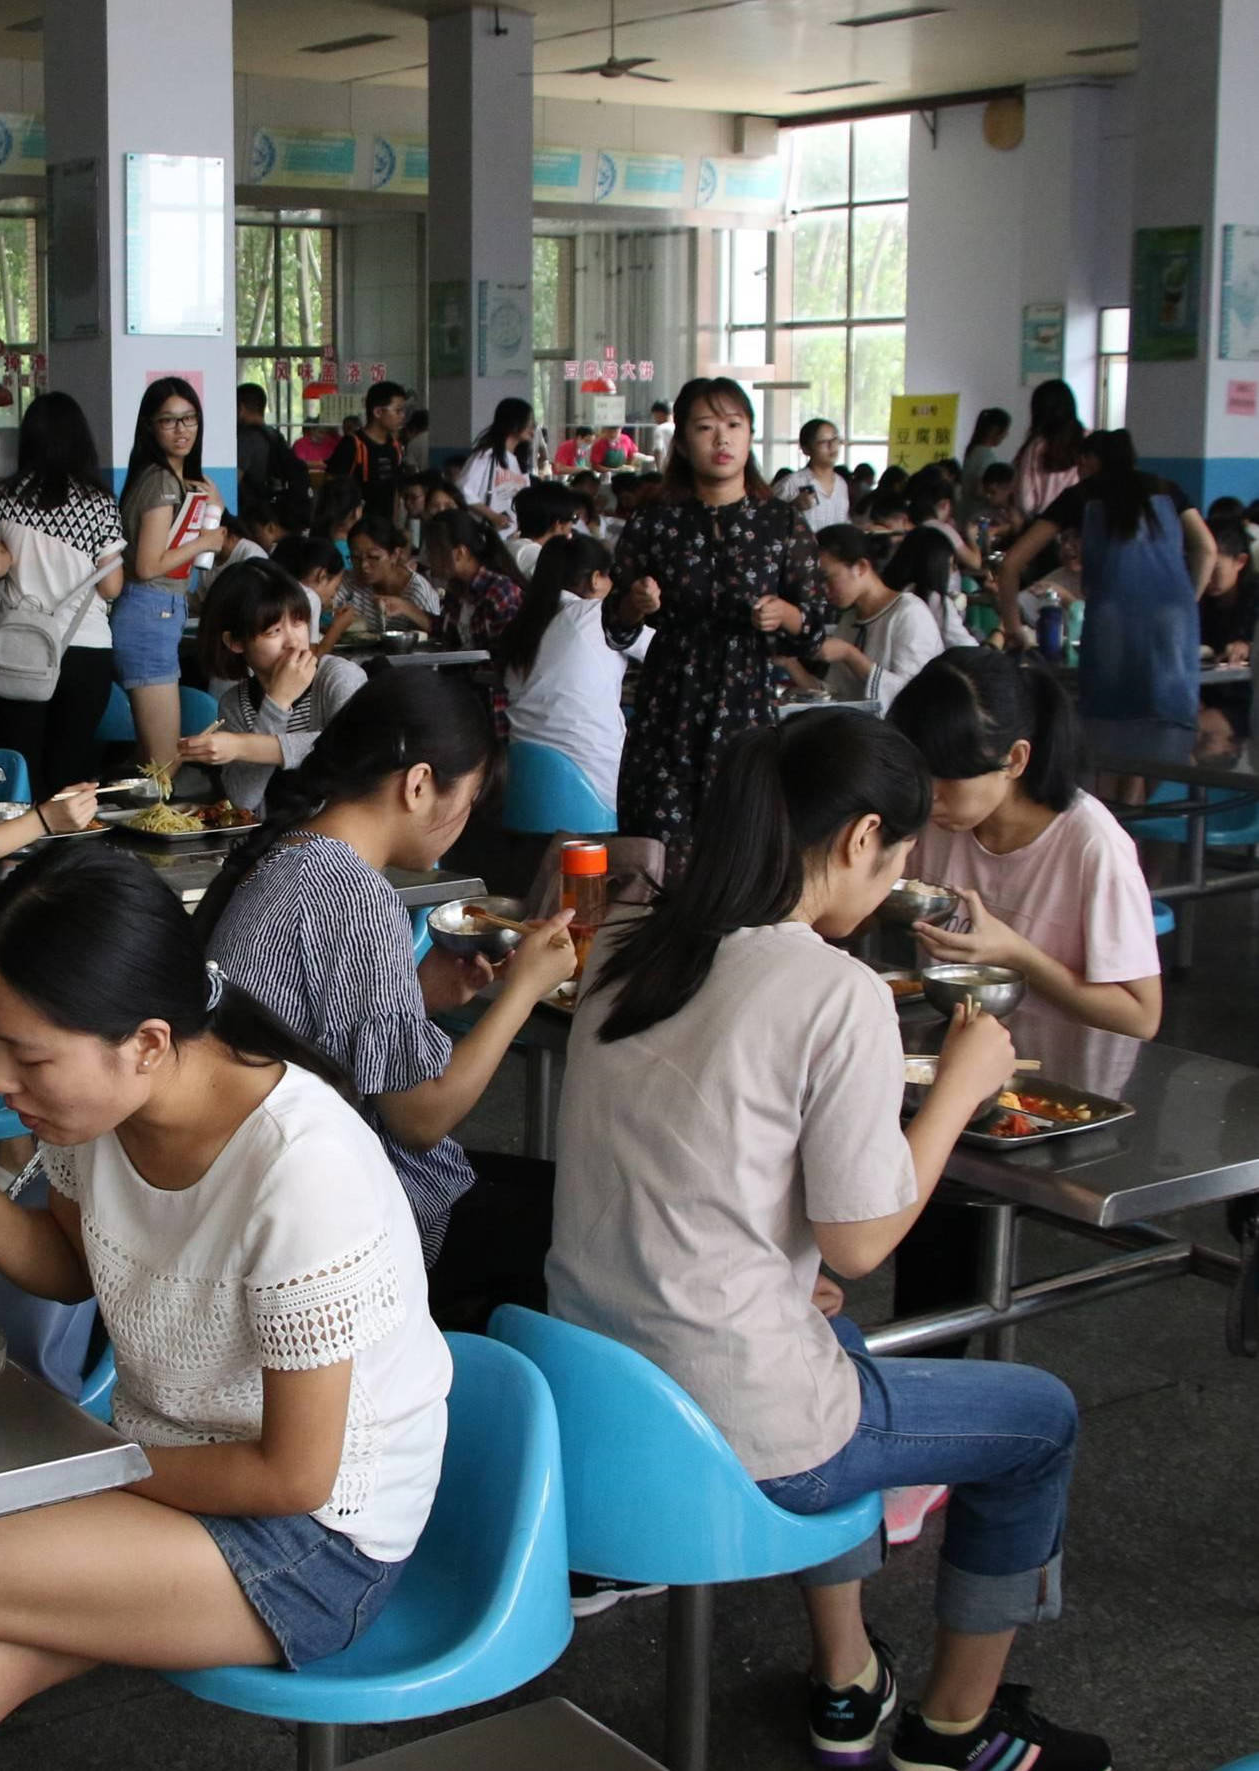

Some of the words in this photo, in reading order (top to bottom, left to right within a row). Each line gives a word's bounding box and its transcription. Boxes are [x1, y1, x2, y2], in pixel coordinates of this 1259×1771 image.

[275, 360, 387, 384] 风味盖浇饭
[895, 428, 950, 445] 豆腐脑
